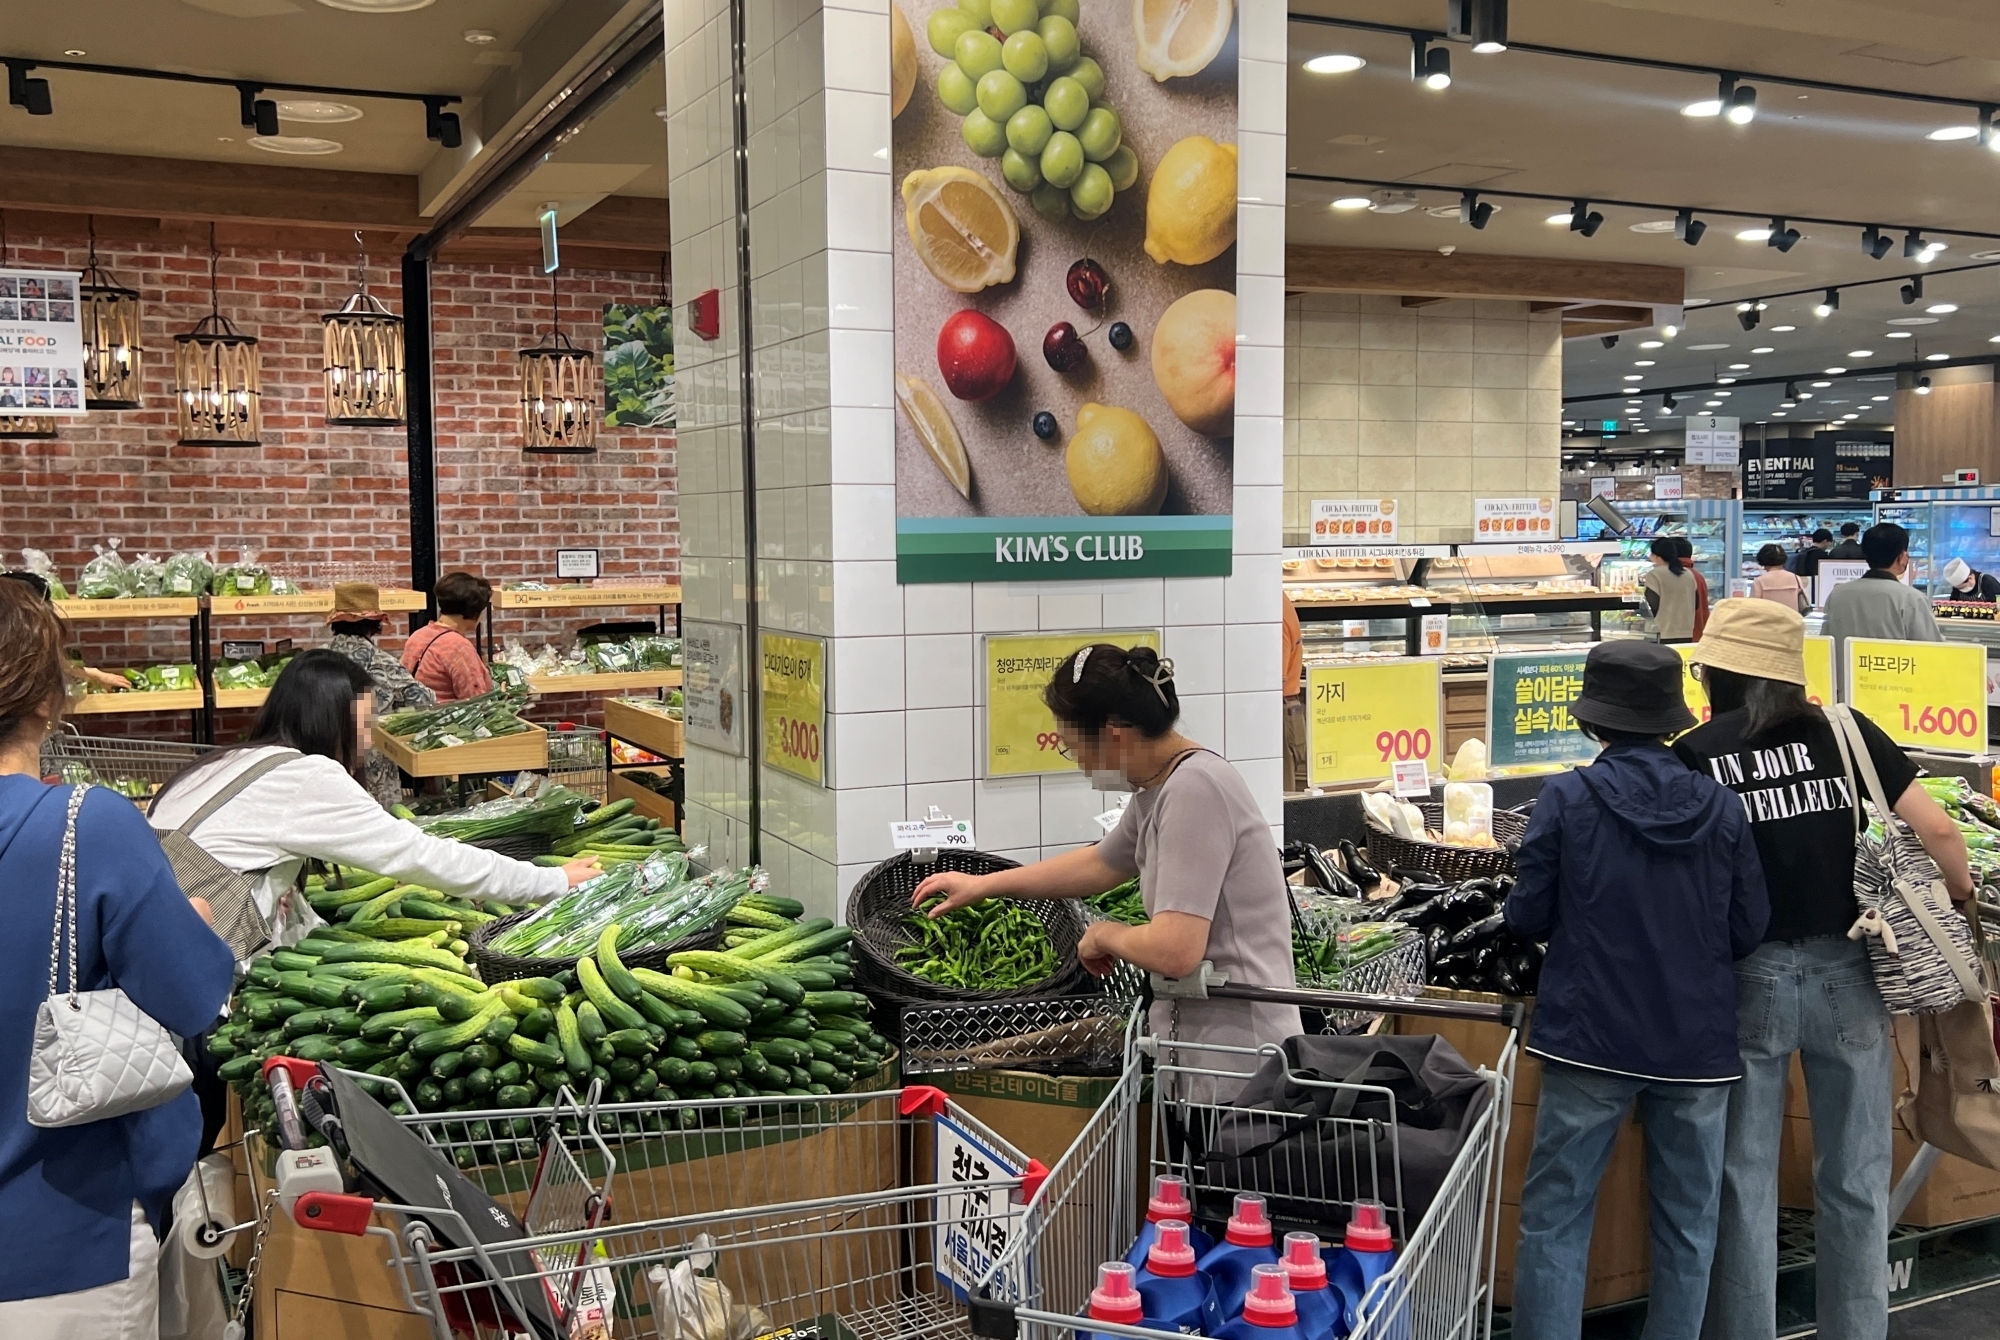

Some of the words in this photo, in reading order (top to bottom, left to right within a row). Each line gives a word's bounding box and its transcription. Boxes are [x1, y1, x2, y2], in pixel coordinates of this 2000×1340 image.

[18, 336, 56, 346] FOOD
[1710, 419, 1716, 428] 3
[1352, 504, 1378, 512] FRITTER
[1512, 503, 1537, 511] FRITTER
[995, 534, 1070, 562] KIM'S
[1075, 535, 1144, 562] CLUB
[1336, 549, 1366, 557] FRITTER
[765, 653, 797, 680] 다다기오이
[798, 659, 812, 682] 6개
[996, 656, 1070, 674] 청양고추/꽈리고
[1859, 655, 1916, 675] 파프리카
[1317, 682, 1345, 703] 가지
[1516, 676, 1584, 704] 쓸어담는
[1899, 704, 1977, 737] 1,600
[780, 716, 819, 762] 3,000
[1036, 732, 1060, 751] 99
[1376, 728, 1431, 762] 900
[1322, 756, 1332, 765] 1개
[1708, 753, 1744, 786] UN
[1752, 742, 1815, 780] JOUR
[947, 835, 967, 844] 990
[954, 1072, 1078, 1102] 한국컨테이너풀
